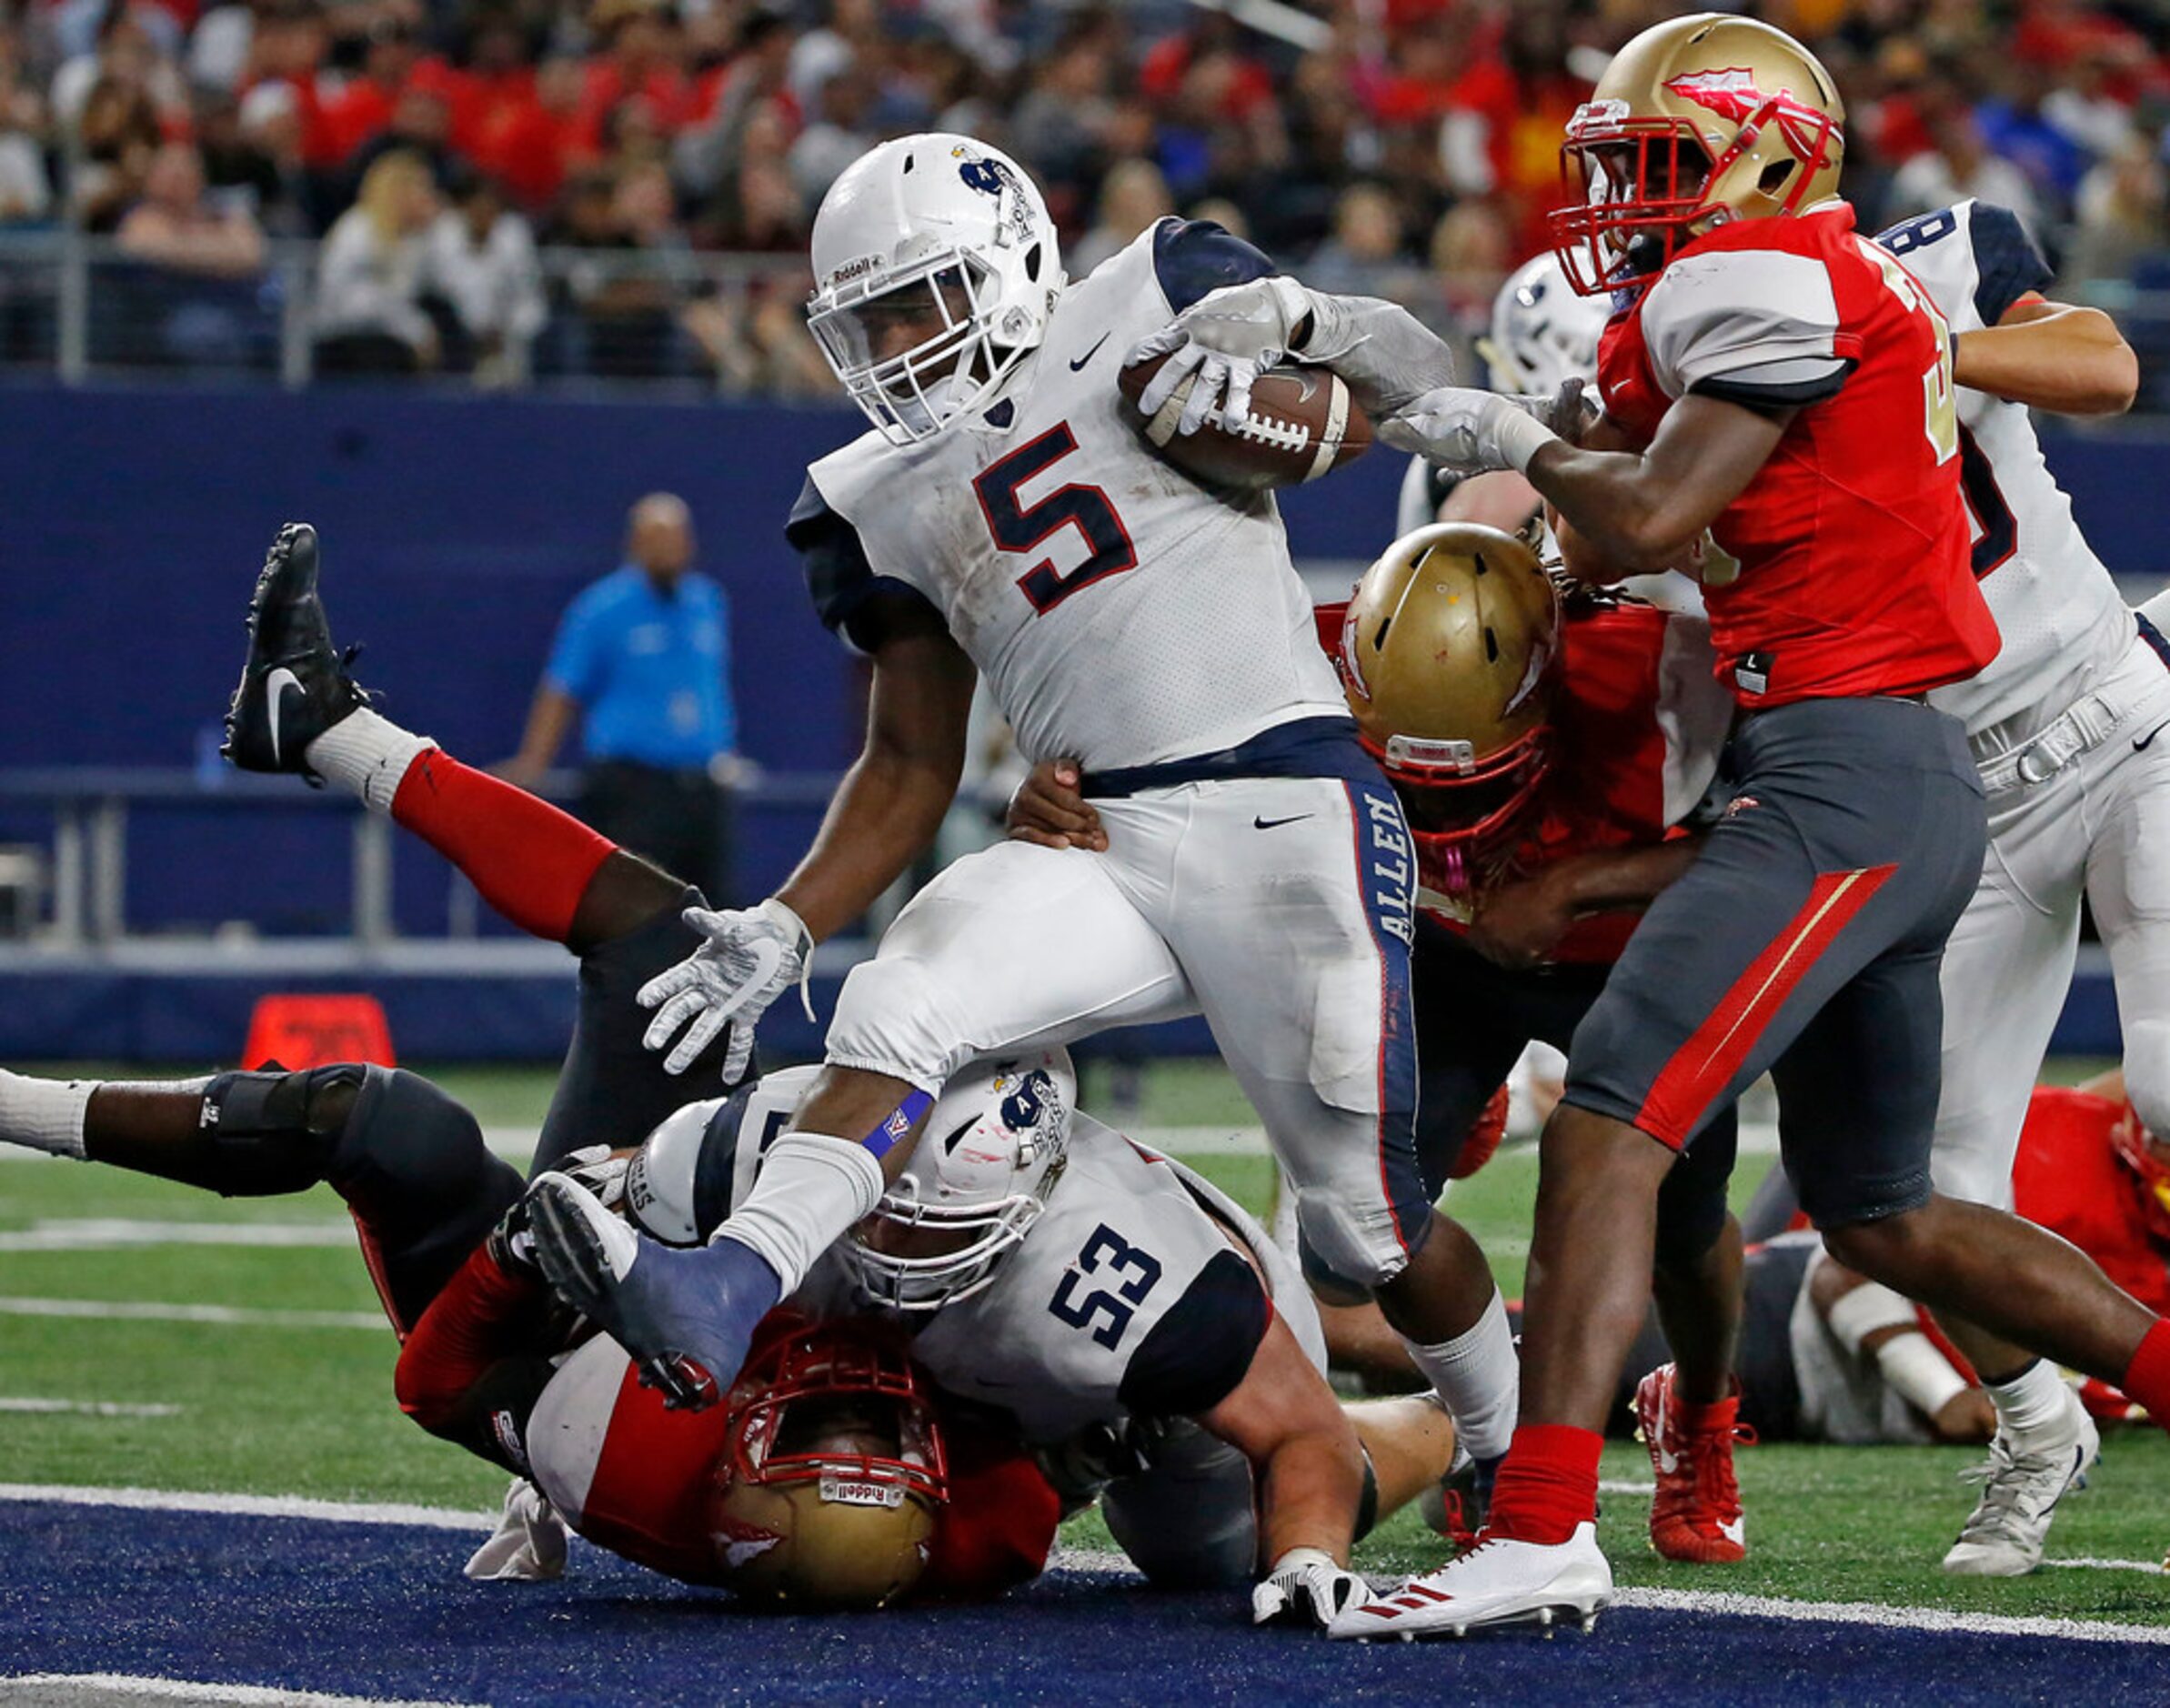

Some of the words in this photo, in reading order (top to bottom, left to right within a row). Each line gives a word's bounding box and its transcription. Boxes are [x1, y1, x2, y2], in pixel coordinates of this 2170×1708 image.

[834, 256, 871, 284] Riddell
[970, 418, 1139, 619] 5
[1746, 654, 1757, 668] L
[1364, 788, 1412, 947] ALLEN
[1048, 1221, 1162, 1353] 53
[838, 1482, 885, 1502] Riddell
